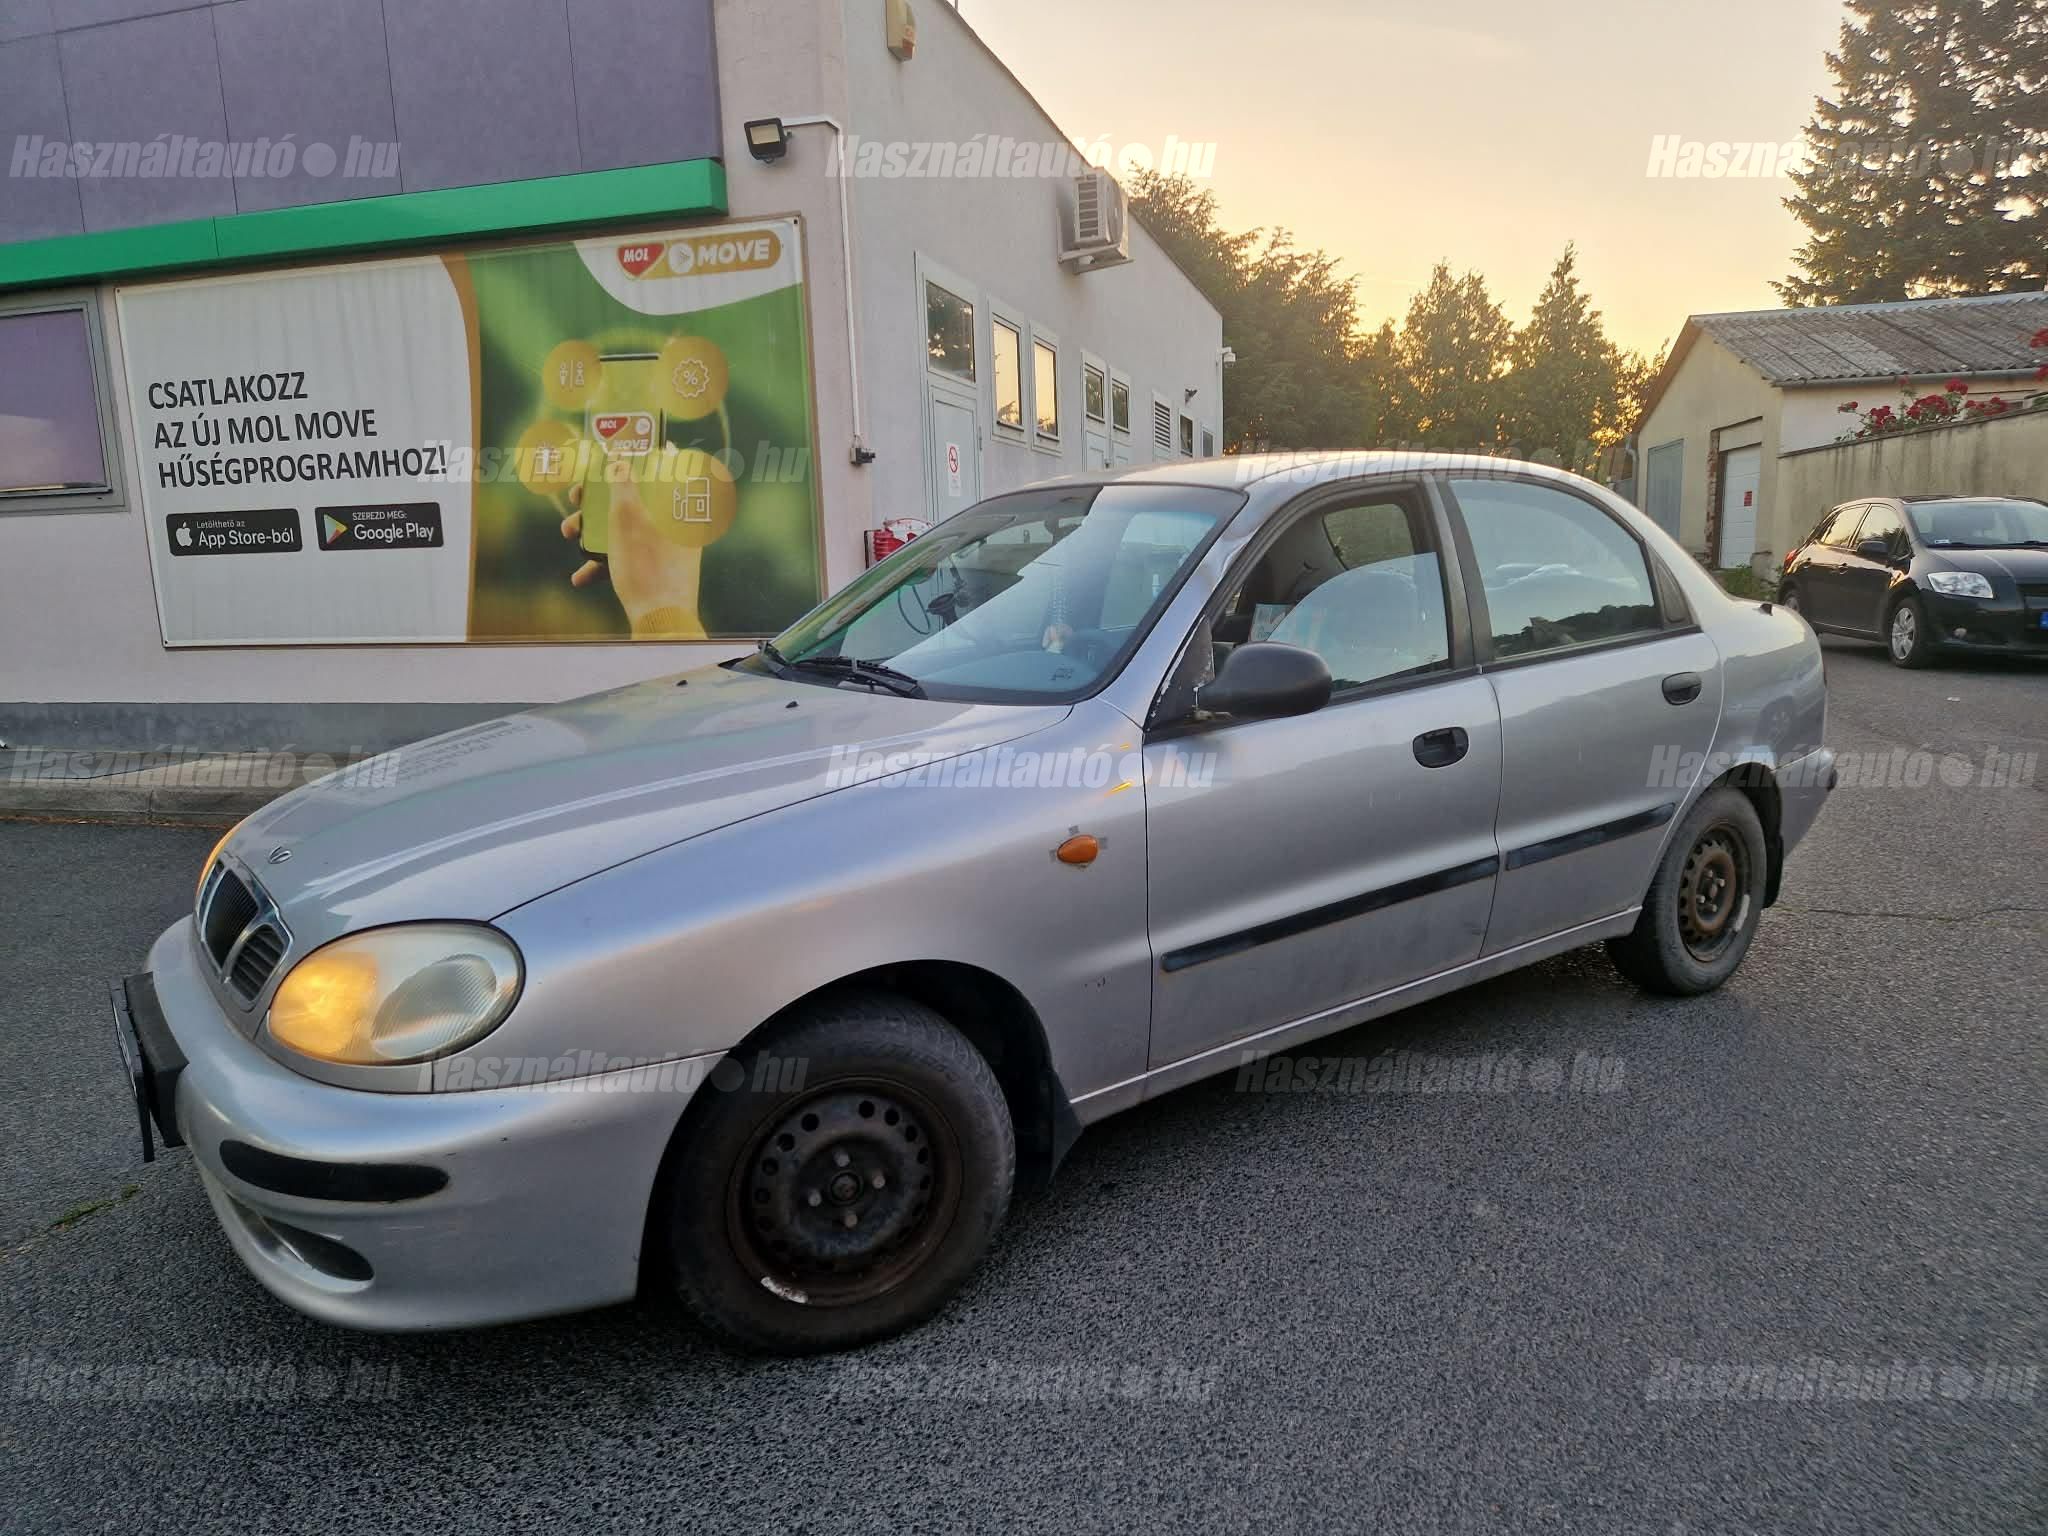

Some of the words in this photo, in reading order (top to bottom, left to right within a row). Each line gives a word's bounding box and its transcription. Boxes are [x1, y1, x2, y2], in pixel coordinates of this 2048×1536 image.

[623, 248, 648, 262] MOL
[697, 239, 770, 266] MOVE
[149, 371, 308, 409] CSATLAKOZZ
[155, 422, 187, 449] AZ
[192, 412, 221, 447] ÚJ
[228, 414, 290, 445] MOL
[295, 409, 378, 440] MOVE
[158, 445, 448, 488] HŰSÉGPROGRAMHOZ!
[196, 520, 235, 529] Letölthető
[352, 511, 386, 521] SZEREZD
[386, 510, 408, 519] MEG:
[198, 530, 226, 549] App
[228, 528, 294, 545] Store-ból
[354, 523, 404, 543] Google
[406, 522, 435, 542] Play
